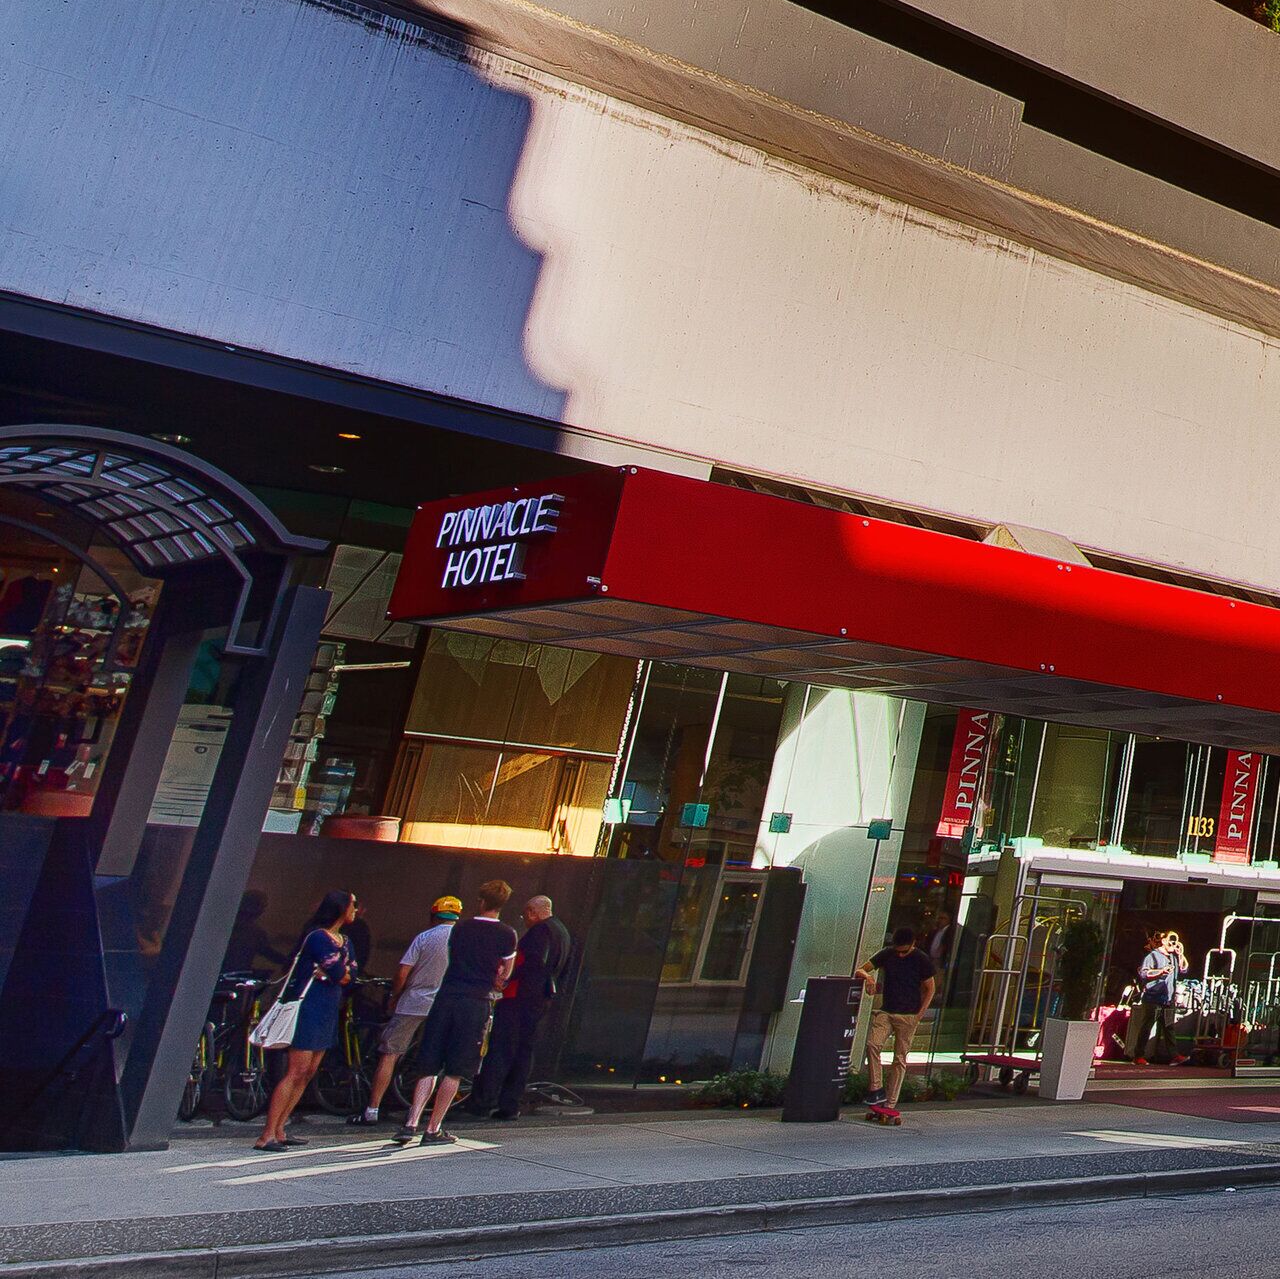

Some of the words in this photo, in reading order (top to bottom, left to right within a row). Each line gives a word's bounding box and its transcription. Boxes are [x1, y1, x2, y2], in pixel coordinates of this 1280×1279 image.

[436, 493, 562, 548] PINNACLE
[441, 542, 524, 589] HOTEL
[1187, 815, 1215, 838] 1133
